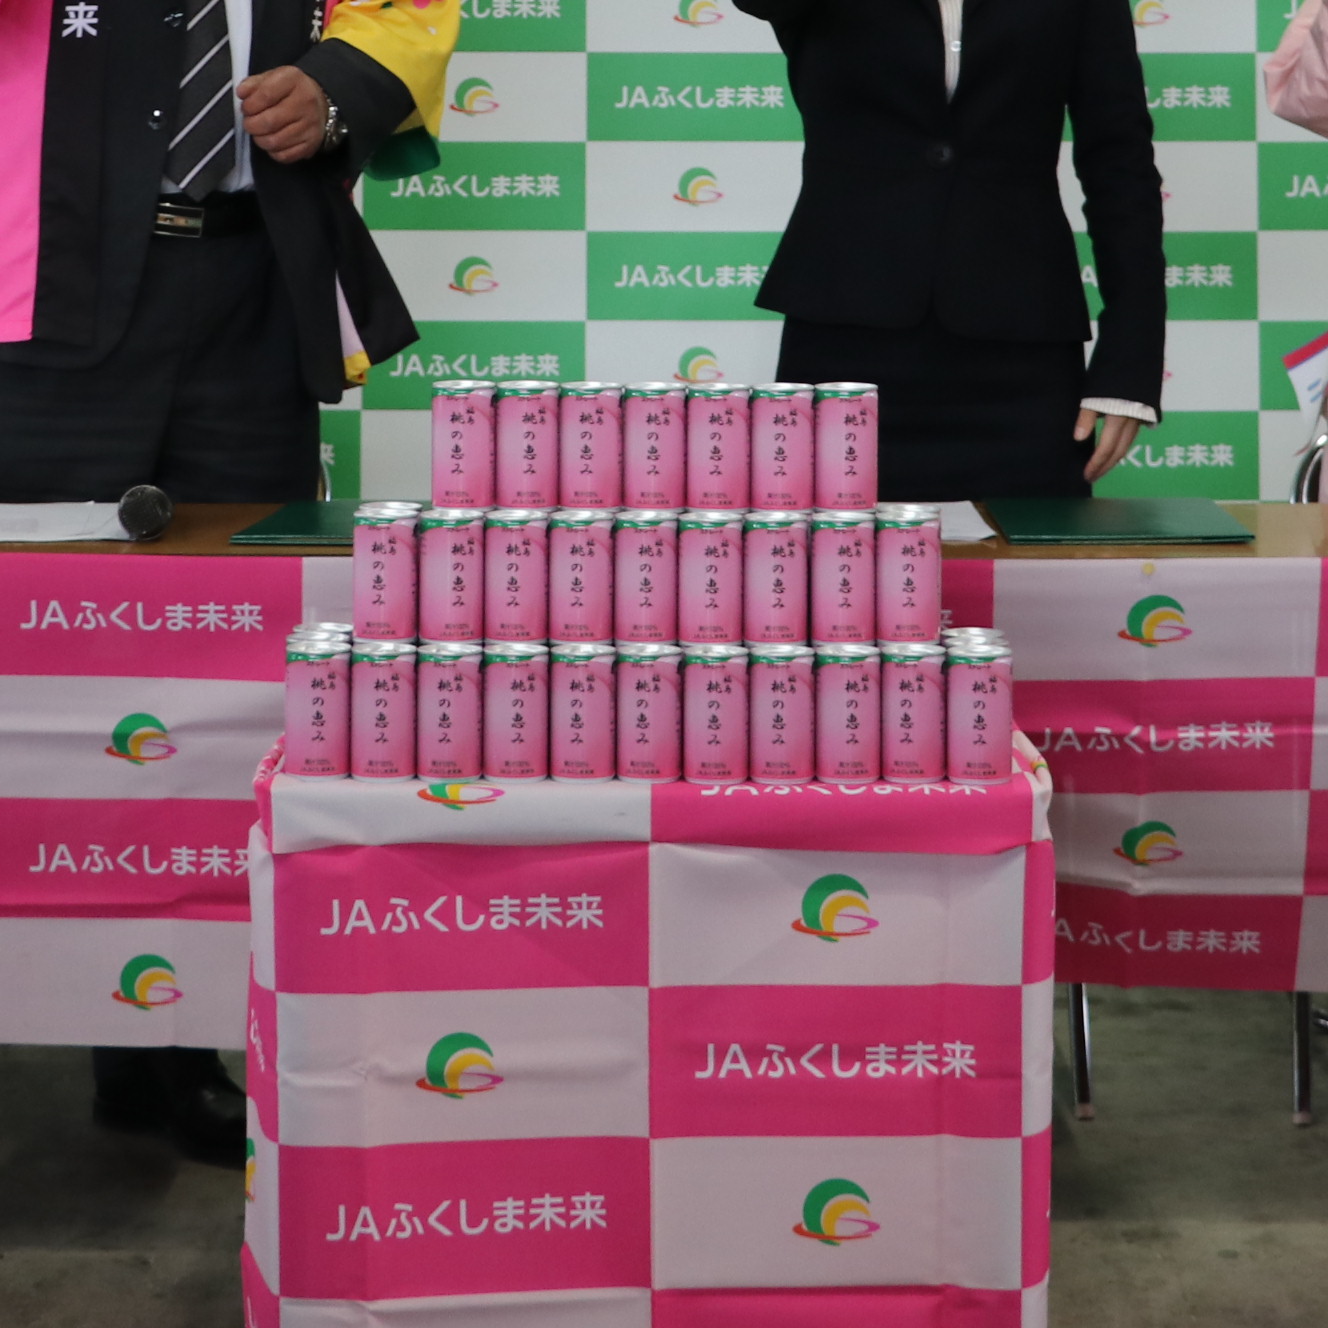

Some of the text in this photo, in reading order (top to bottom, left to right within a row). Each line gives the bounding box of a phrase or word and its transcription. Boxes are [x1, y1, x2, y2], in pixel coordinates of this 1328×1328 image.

[616, 86, 785, 110] JAふくしま未来
[391, 174, 562, 199] JAふくしま未来
[615, 264, 769, 289] JAふくしま未
[391, 354, 561, 378] JAふくしま未来
[450, 412, 465, 475] 桃の恵み
[523, 412, 538, 475] 桃の恵み
[579, 412, 594, 475] 桃の恵み
[646, 413, 661, 476] 桃の恵み
[709, 413, 724, 476] 桃の恵み
[773, 414, 788, 477] 桃の恵み
[844, 414, 859, 477] 桃の恵み
[1120, 442, 1235, 468] くしま未来
[371, 540, 387, 606] 桃の恵み
[451, 541, 467, 607] 桃の恵み
[505, 542, 521, 608] 桃の恵み
[570, 542, 586, 608] 桃の恵み
[638, 543, 654, 609] 桃の恵み
[704, 544, 720, 610] 桃の恵み
[771, 543, 787, 609] 桃の恵み
[838, 543, 854, 609] 桃の恵み
[901, 543, 917, 609] 桃の恵み
[21, 600, 264, 633] JAふくしま未来
[311, 676, 327, 742] 桃の恵み
[374, 677, 390, 743] 桃の恵み
[437, 678, 453, 744] 桃の恵み
[511, 678, 527, 744] 桃の恵み
[569, 678, 585, 744] 桃の恵み
[635, 678, 651, 744] 桃の恵み
[707, 679, 723, 745] 桃の恵み
[771, 679, 787, 745] 桃の恵み
[845, 679, 861, 745] 桃の恵み
[899, 678, 915, 744] 桃の恵み
[972, 679, 988, 745] 桃の恵み
[1036, 721, 1276, 754] JAふくしま未来
[321, 894, 605, 936] JAふくしま未来
[1054, 919, 1262, 955] Aふくしま未来
[695, 1041, 977, 1080] JAふくしま未来
[327, 1193, 608, 1242] JAふくしま未来
